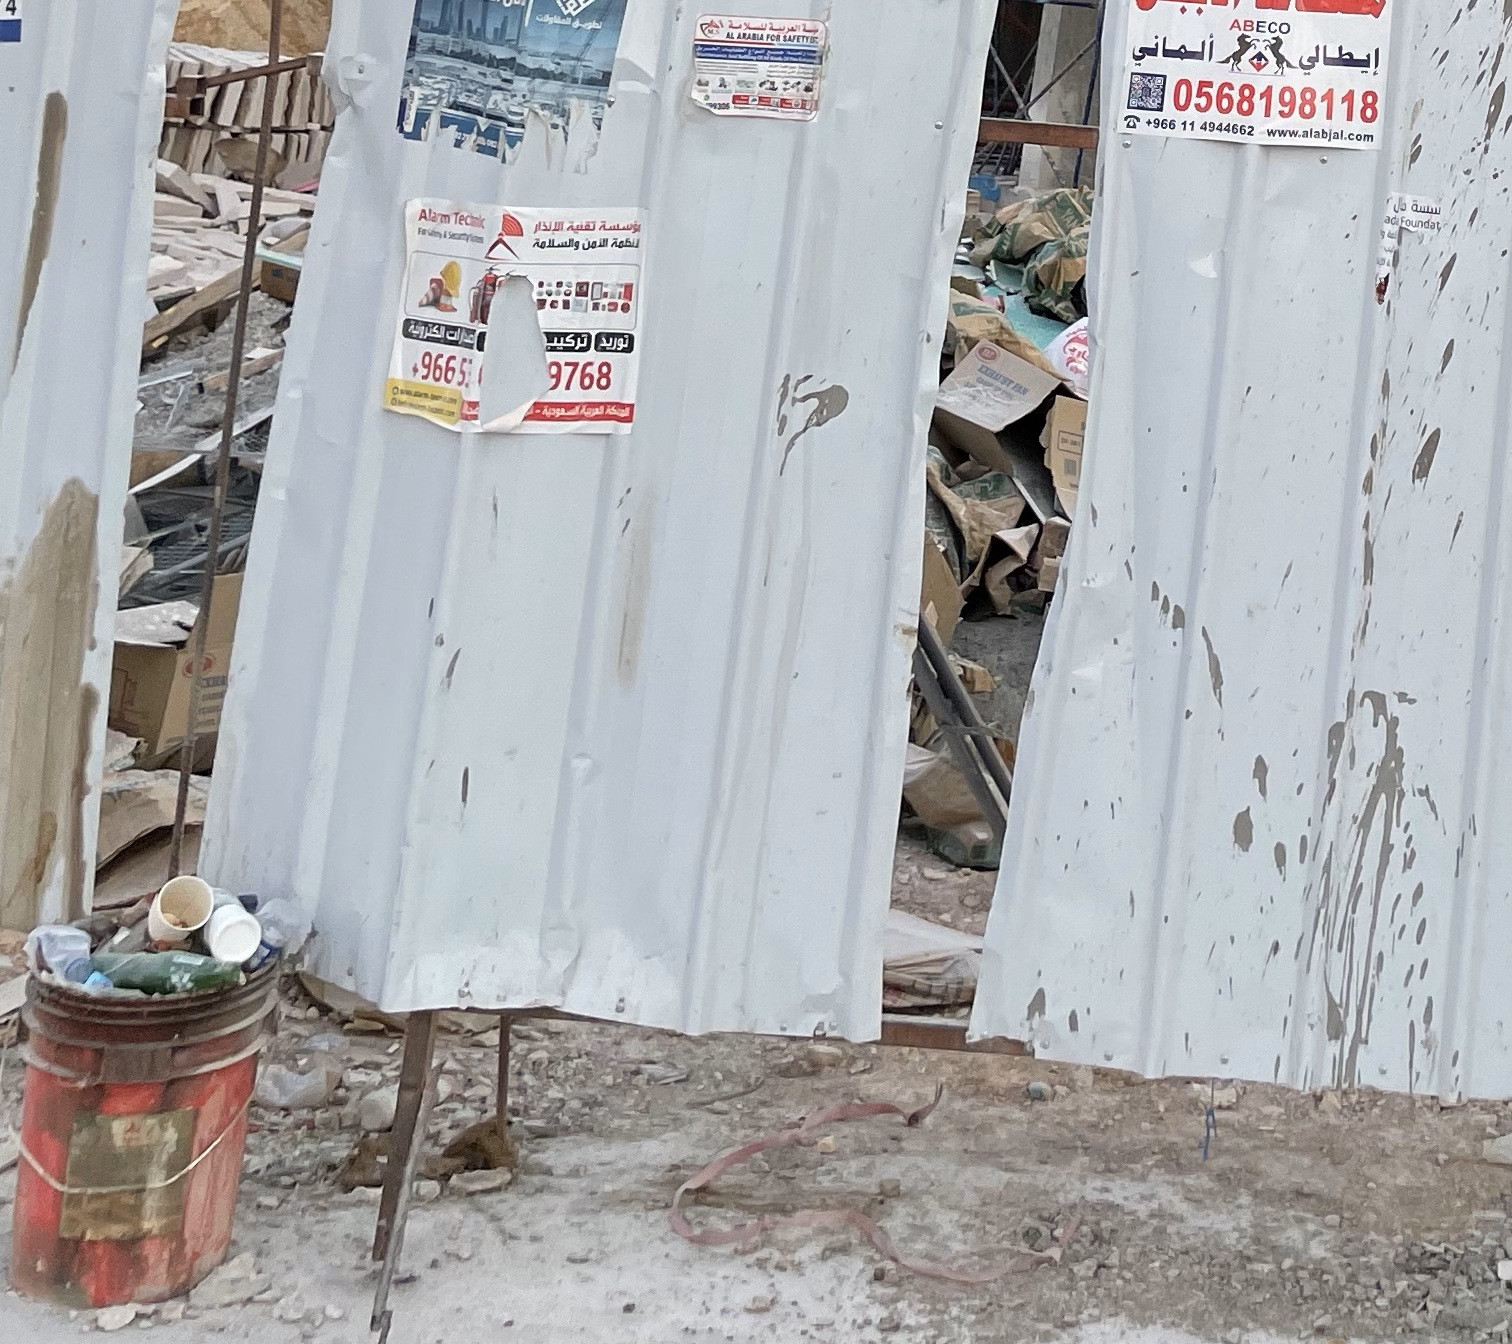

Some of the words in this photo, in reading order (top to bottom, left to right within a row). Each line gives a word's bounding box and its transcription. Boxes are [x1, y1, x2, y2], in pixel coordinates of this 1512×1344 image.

[1229, 19, 1291, 35] ABECO
[1132, 33, 1215, 66] ألماني
[1173, 78, 1379, 123] 0568198118
[1145, 118, 1176, 131] +966
[1181, 120, 1195, 132] 11
[1200, 122, 1255, 137] 4944662
[1266, 127, 1374, 143] www.alabjal.com
[567, 220, 597, 234] تقنية
[532, 237, 580, 251] والسلامة
[599, 334, 629, 351] توريد
